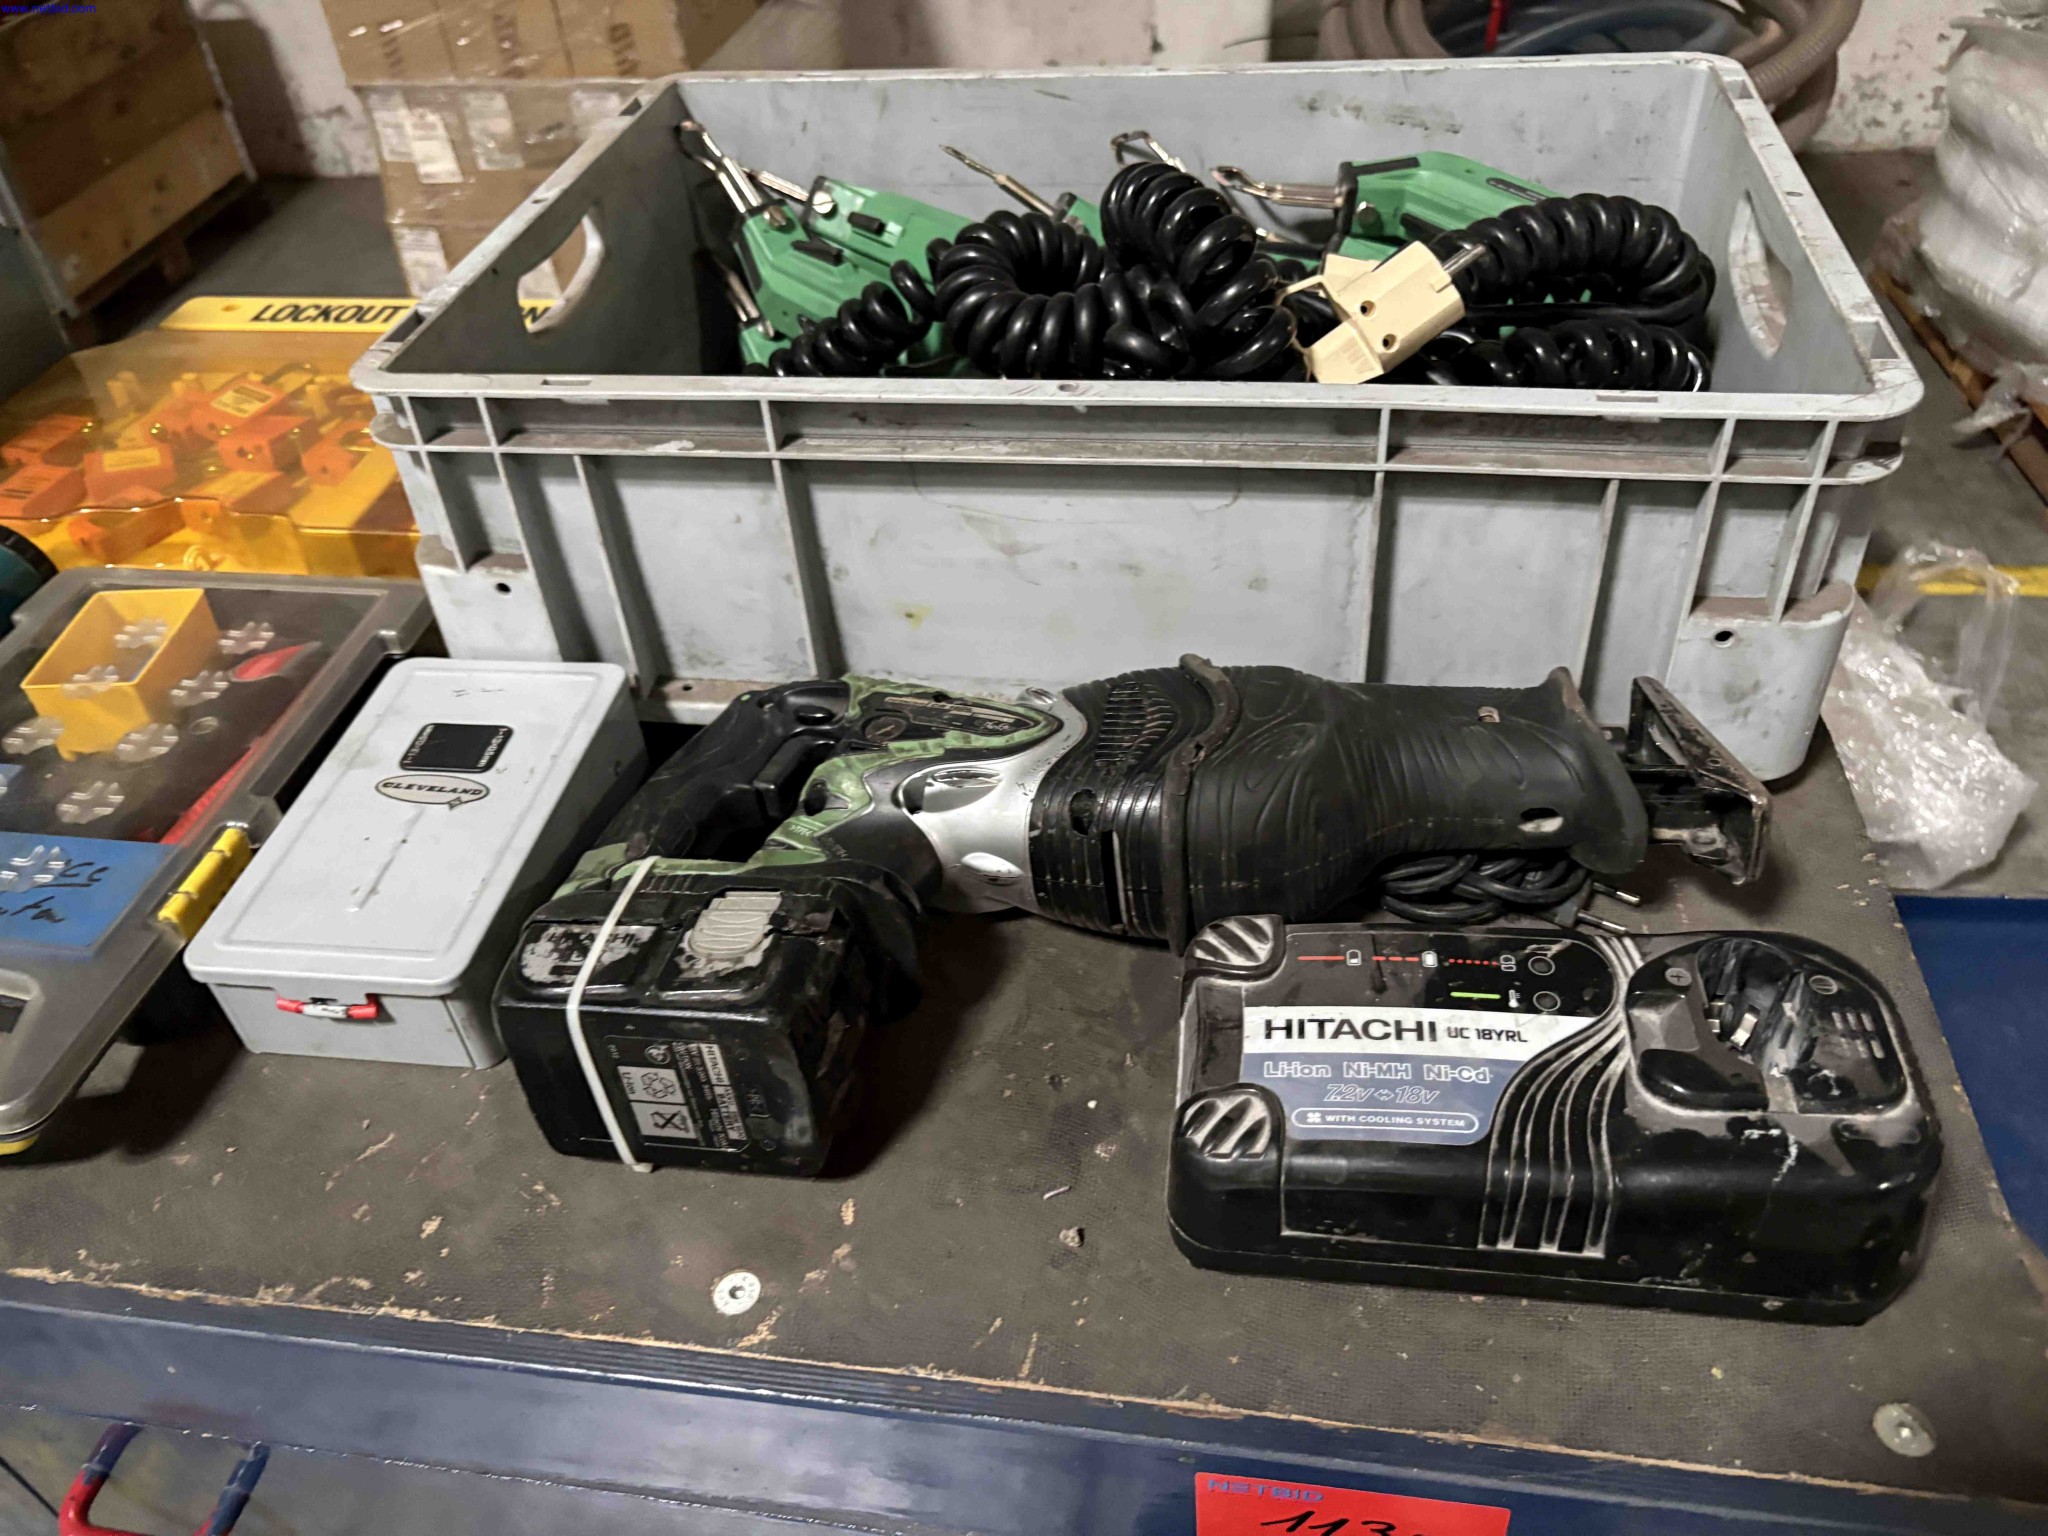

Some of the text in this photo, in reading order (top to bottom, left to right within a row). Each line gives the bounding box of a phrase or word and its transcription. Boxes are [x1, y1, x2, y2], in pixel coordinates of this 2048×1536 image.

[250, 304, 409, 323] LOCKOUT
[382, 781, 484, 796] CLEVELAND
[1264, 1018, 1528, 1043] HITACHI UC 18YRL
[1263, 1061, 1491, 1084] Li-ion Ni-MH Ni-Cd
[1325, 1114, 1466, 1127] WITH COOLING SYSTEM
[1208, 1479, 1324, 1502] NETBID
